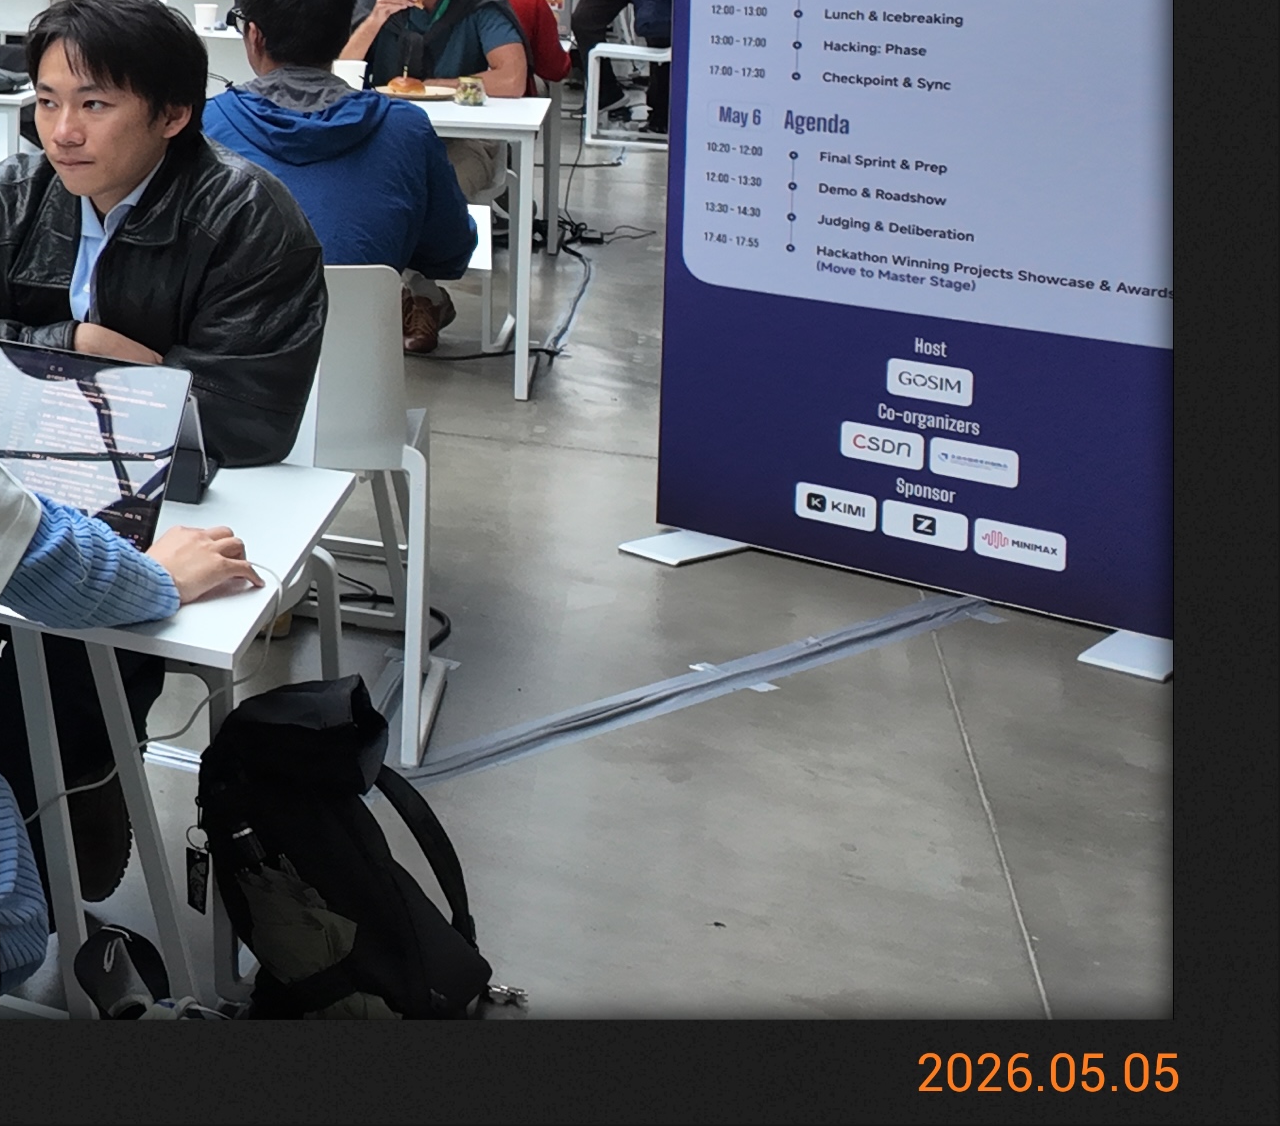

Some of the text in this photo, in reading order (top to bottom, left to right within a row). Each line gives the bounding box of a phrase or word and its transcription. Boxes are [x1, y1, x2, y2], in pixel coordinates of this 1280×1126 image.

[824, 9, 964, 28] Lunch & Icebreaking
[823, 40, 927, 56] Hacking: Phase
[822, 71, 951, 92] Checkpoint & Sync
[719, 105, 850, 135] May 6 Agenda
[819, 151, 948, 176] Final Sprint & Prep
[818, 183, 947, 206] Demo & Roadshow
[817, 215, 975, 242] Judging & Deliberation
[816, 245, 888, 264] Hackathon
[892, 254, 950, 274] Winning
[953, 262, 1014, 280] Projects
[1018, 270, 1095, 290] Showcase
[1099, 280, 1111, 292] &
[816, 260, 977, 293] (Move to Master Stage)
[914, 337, 948, 358] Host
[898, 370, 962, 394] GOSIM
[878, 402, 981, 436] Co-organizers
[896, 477, 956, 504] Sponsor
[831, 500, 866, 519] KIMI
[1011, 539, 1058, 556] MINIMAX
